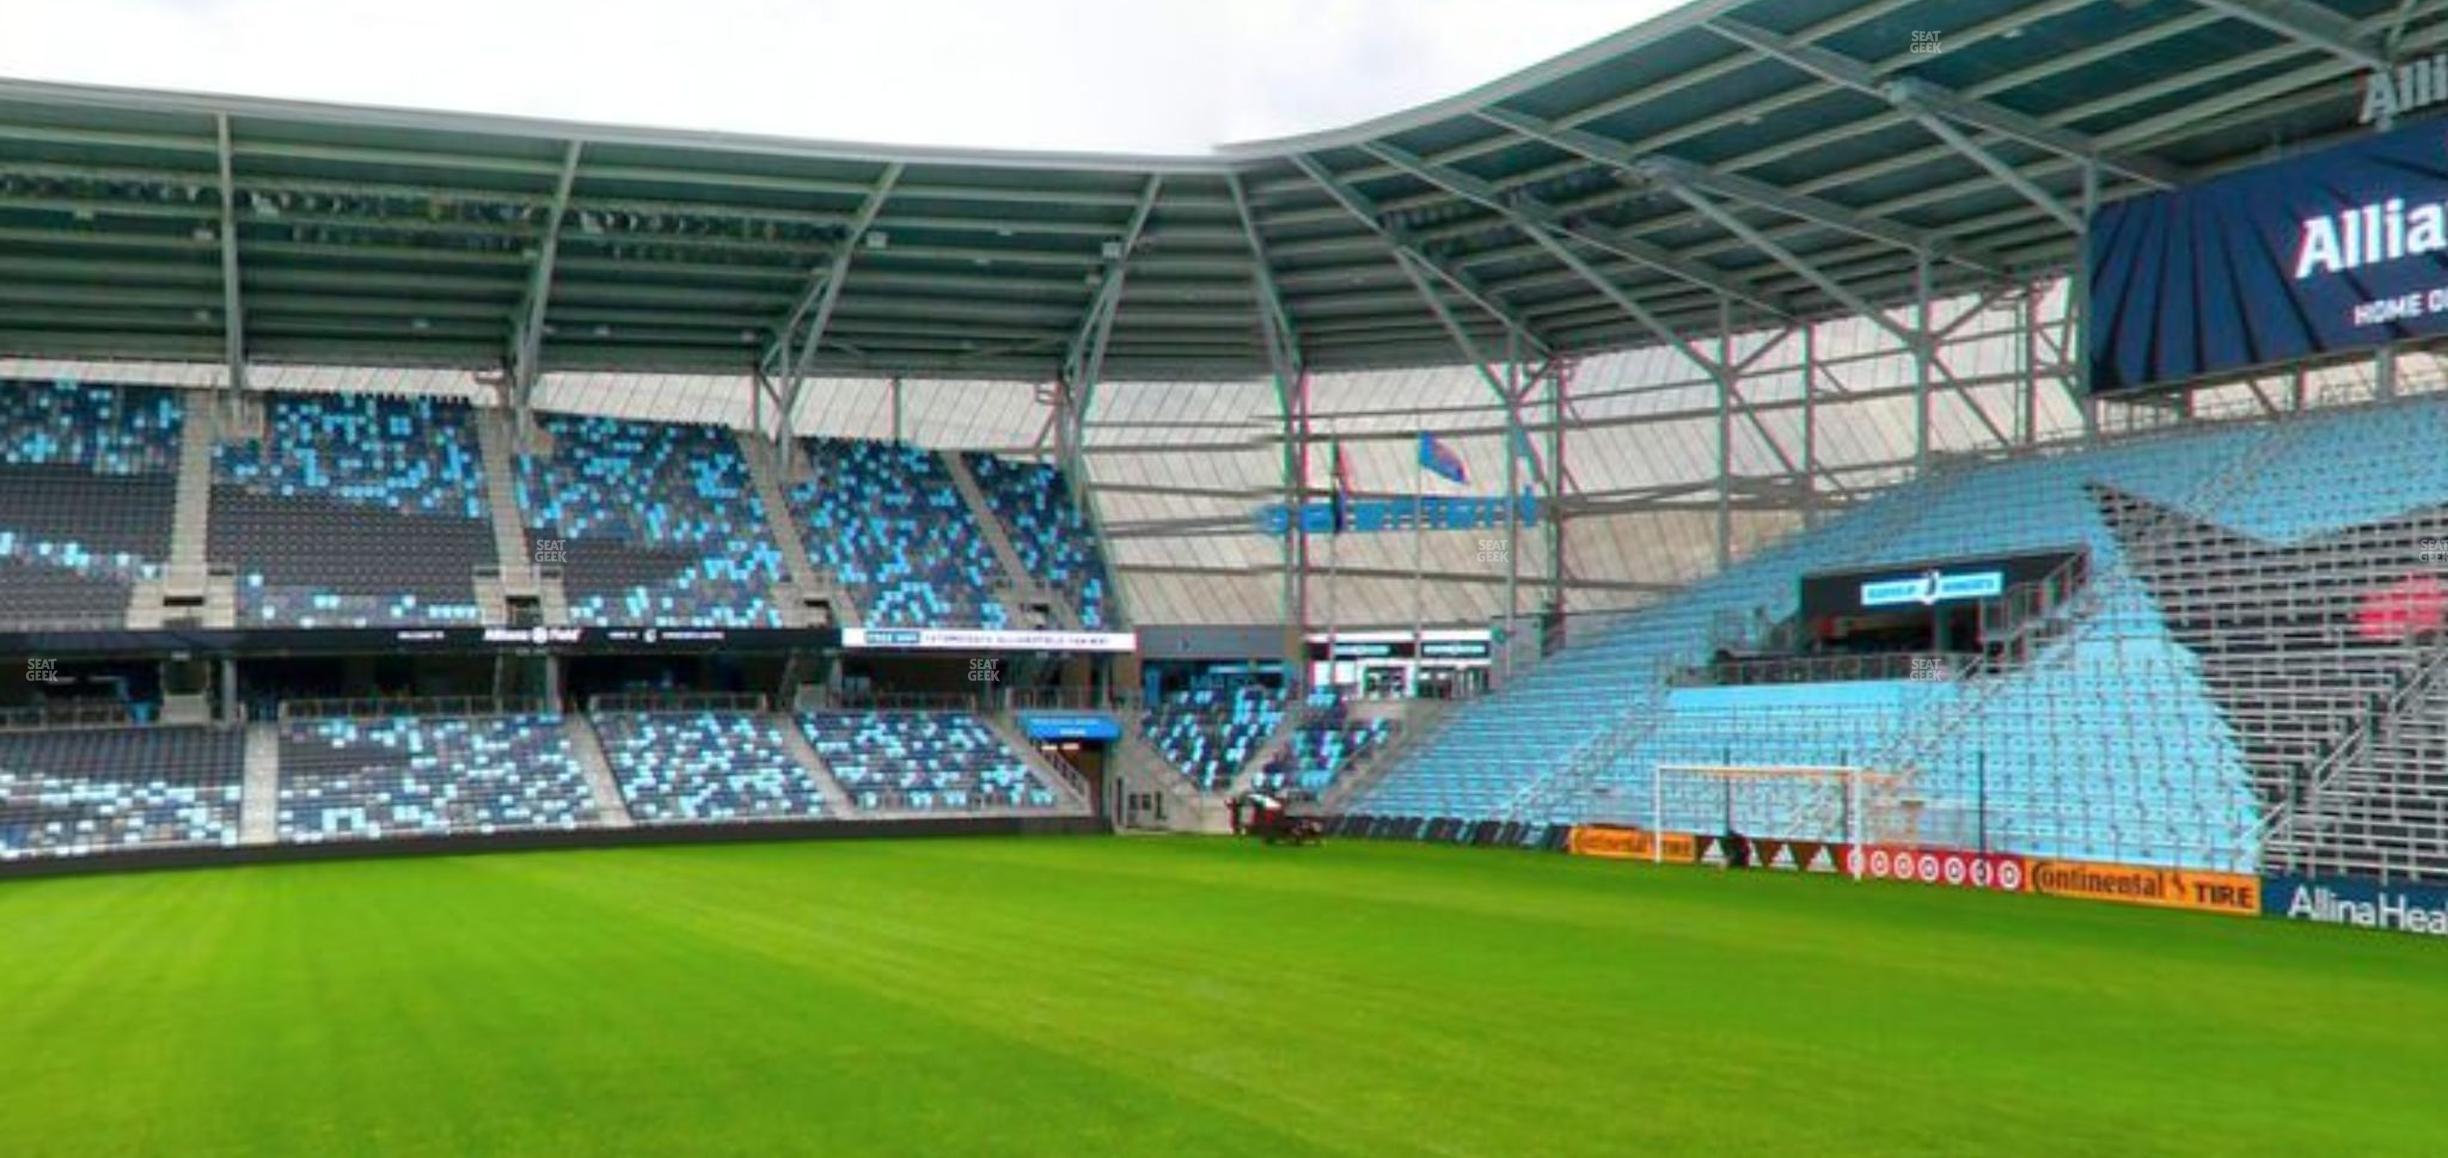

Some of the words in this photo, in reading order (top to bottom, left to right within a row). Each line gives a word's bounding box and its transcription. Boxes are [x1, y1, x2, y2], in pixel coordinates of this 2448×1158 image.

[2295, 198, 2448, 279] Allia
[2353, 293, 2423, 327] HOME
[2032, 861, 2165, 899] Continental
[2194, 881, 2253, 909] TIRE
